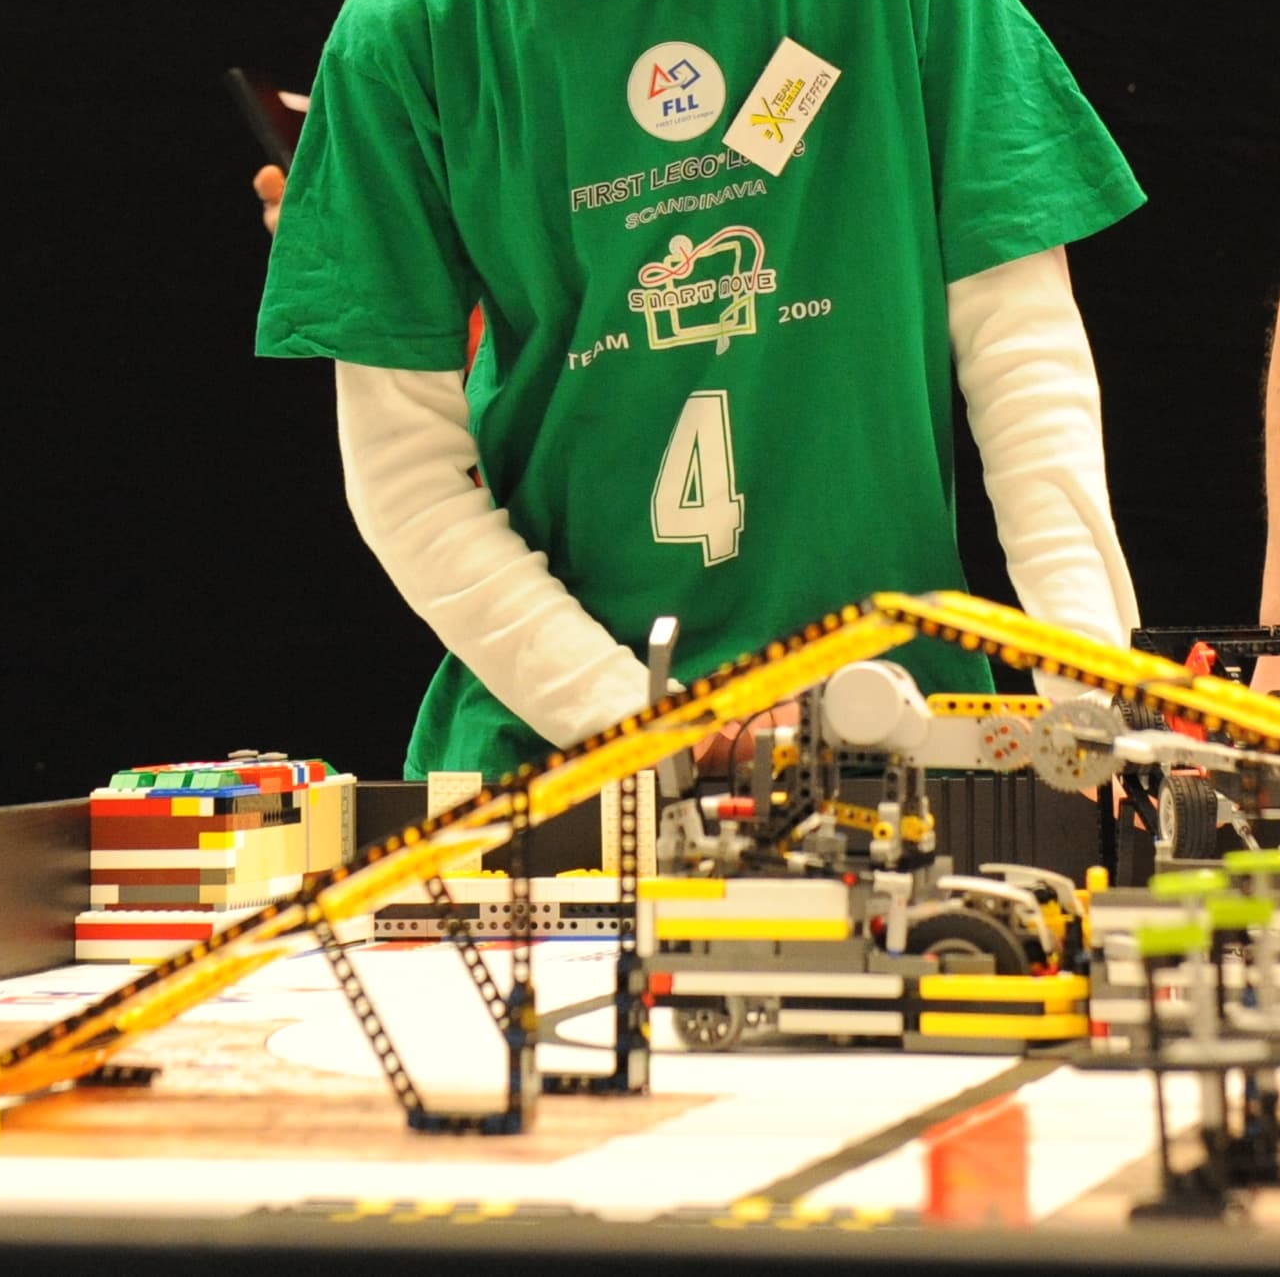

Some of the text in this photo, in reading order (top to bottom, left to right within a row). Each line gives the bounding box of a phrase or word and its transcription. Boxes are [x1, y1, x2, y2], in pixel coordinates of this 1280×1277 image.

[662, 94, 699, 117] FLL
[771, 79, 795, 107] TEAM
[798, 70, 832, 116] STEFFEN
[571, 173, 645, 212] FIRST
[624, 178, 768, 230] SCANDINAVIA
[778, 298, 832, 323] 2009
[567, 332, 630, 371] TEAM
[649, 389, 745, 568] 4
